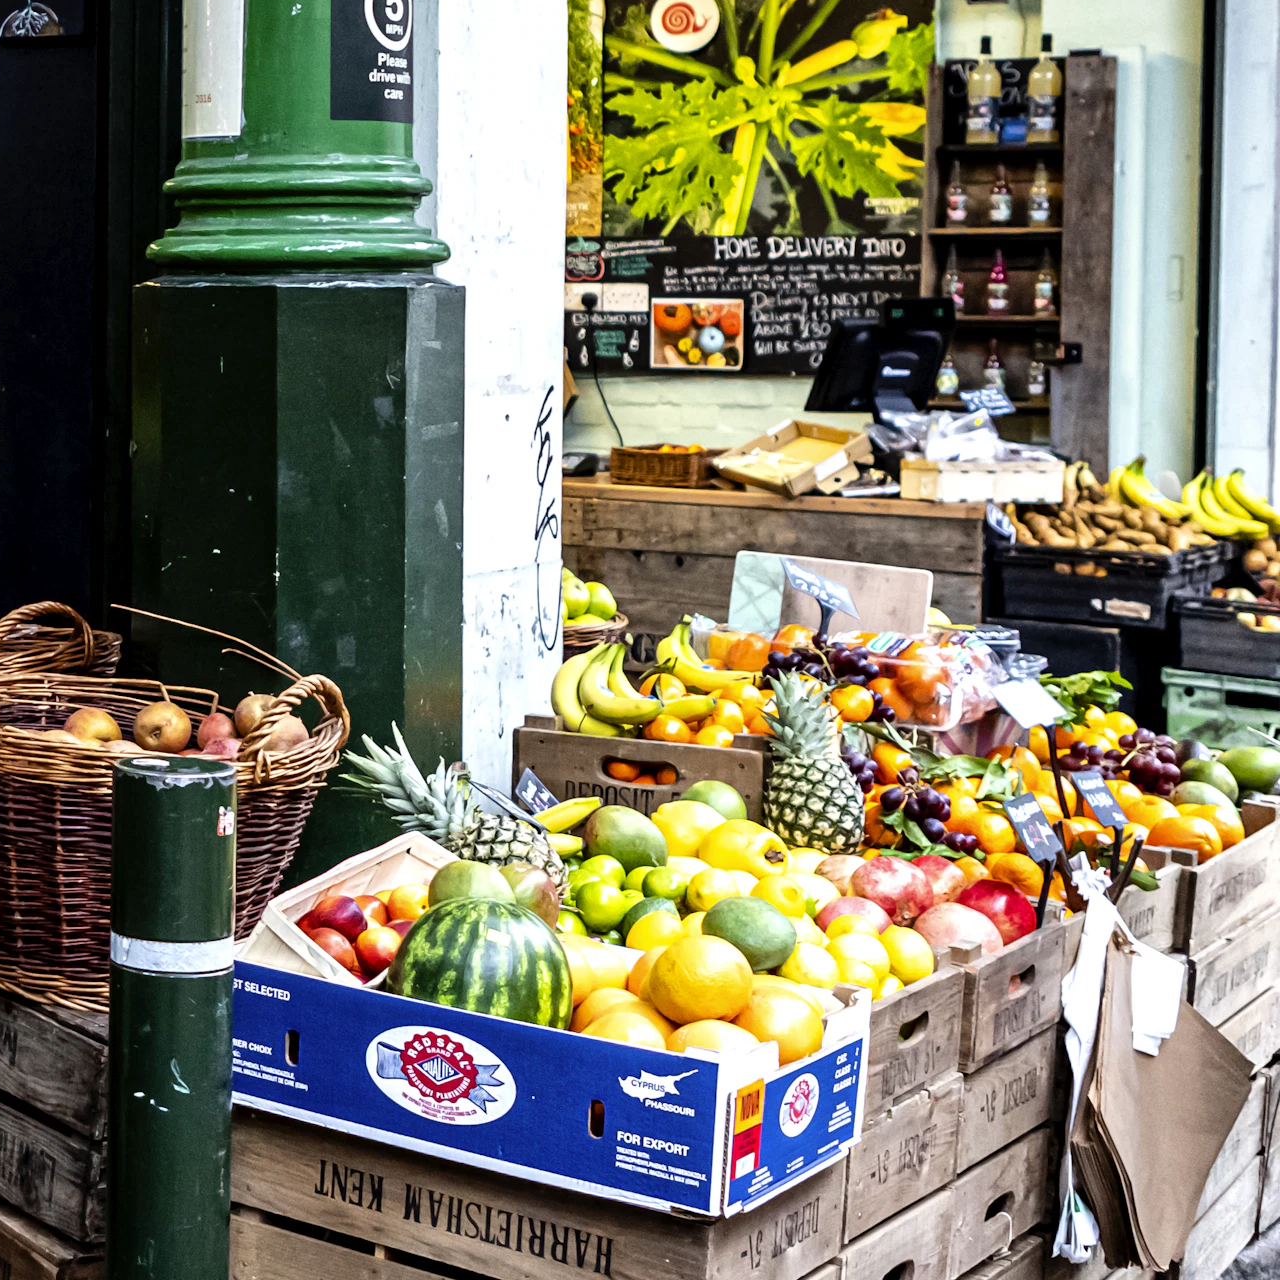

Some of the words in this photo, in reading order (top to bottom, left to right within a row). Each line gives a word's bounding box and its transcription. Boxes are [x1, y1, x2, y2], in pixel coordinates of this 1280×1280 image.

[386, 23, 404, 36] MPH
[378, 52, 407, 69] Please
[369, 69, 396, 83] drive
[384, 88, 404, 100] care
[714, 237, 761, 261] HOME
[768, 236, 856, 259] DELIVERY
[862, 238, 906, 258] INFO
[832, 292, 869, 306] NEXT
[245, 981, 290, 1001] SELECTED
[248, 1042, 272, 1055] CHOIX
[407, 1037, 432, 1058] RED
[436, 1038, 469, 1069] SEAL
[426, 1047, 451, 1058] BRAND
[422, 1056, 454, 1081] QUALITY
[406, 1065, 433, 1096] PHASSOURI
[436, 1077, 470, 1099] PLANTATIONS
[631, 1079, 666, 1093] CYPRUS
[645, 1099, 695, 1117] PHASSOURI
[617, 1131, 641, 1146] FOR
[643, 1137, 690, 1157] EXPORT
[315, 1159, 384, 1213] KENT
[403, 1183, 615, 1276] HARRIETSHAM
[771, 1196, 821, 1259] DEPOSIT
